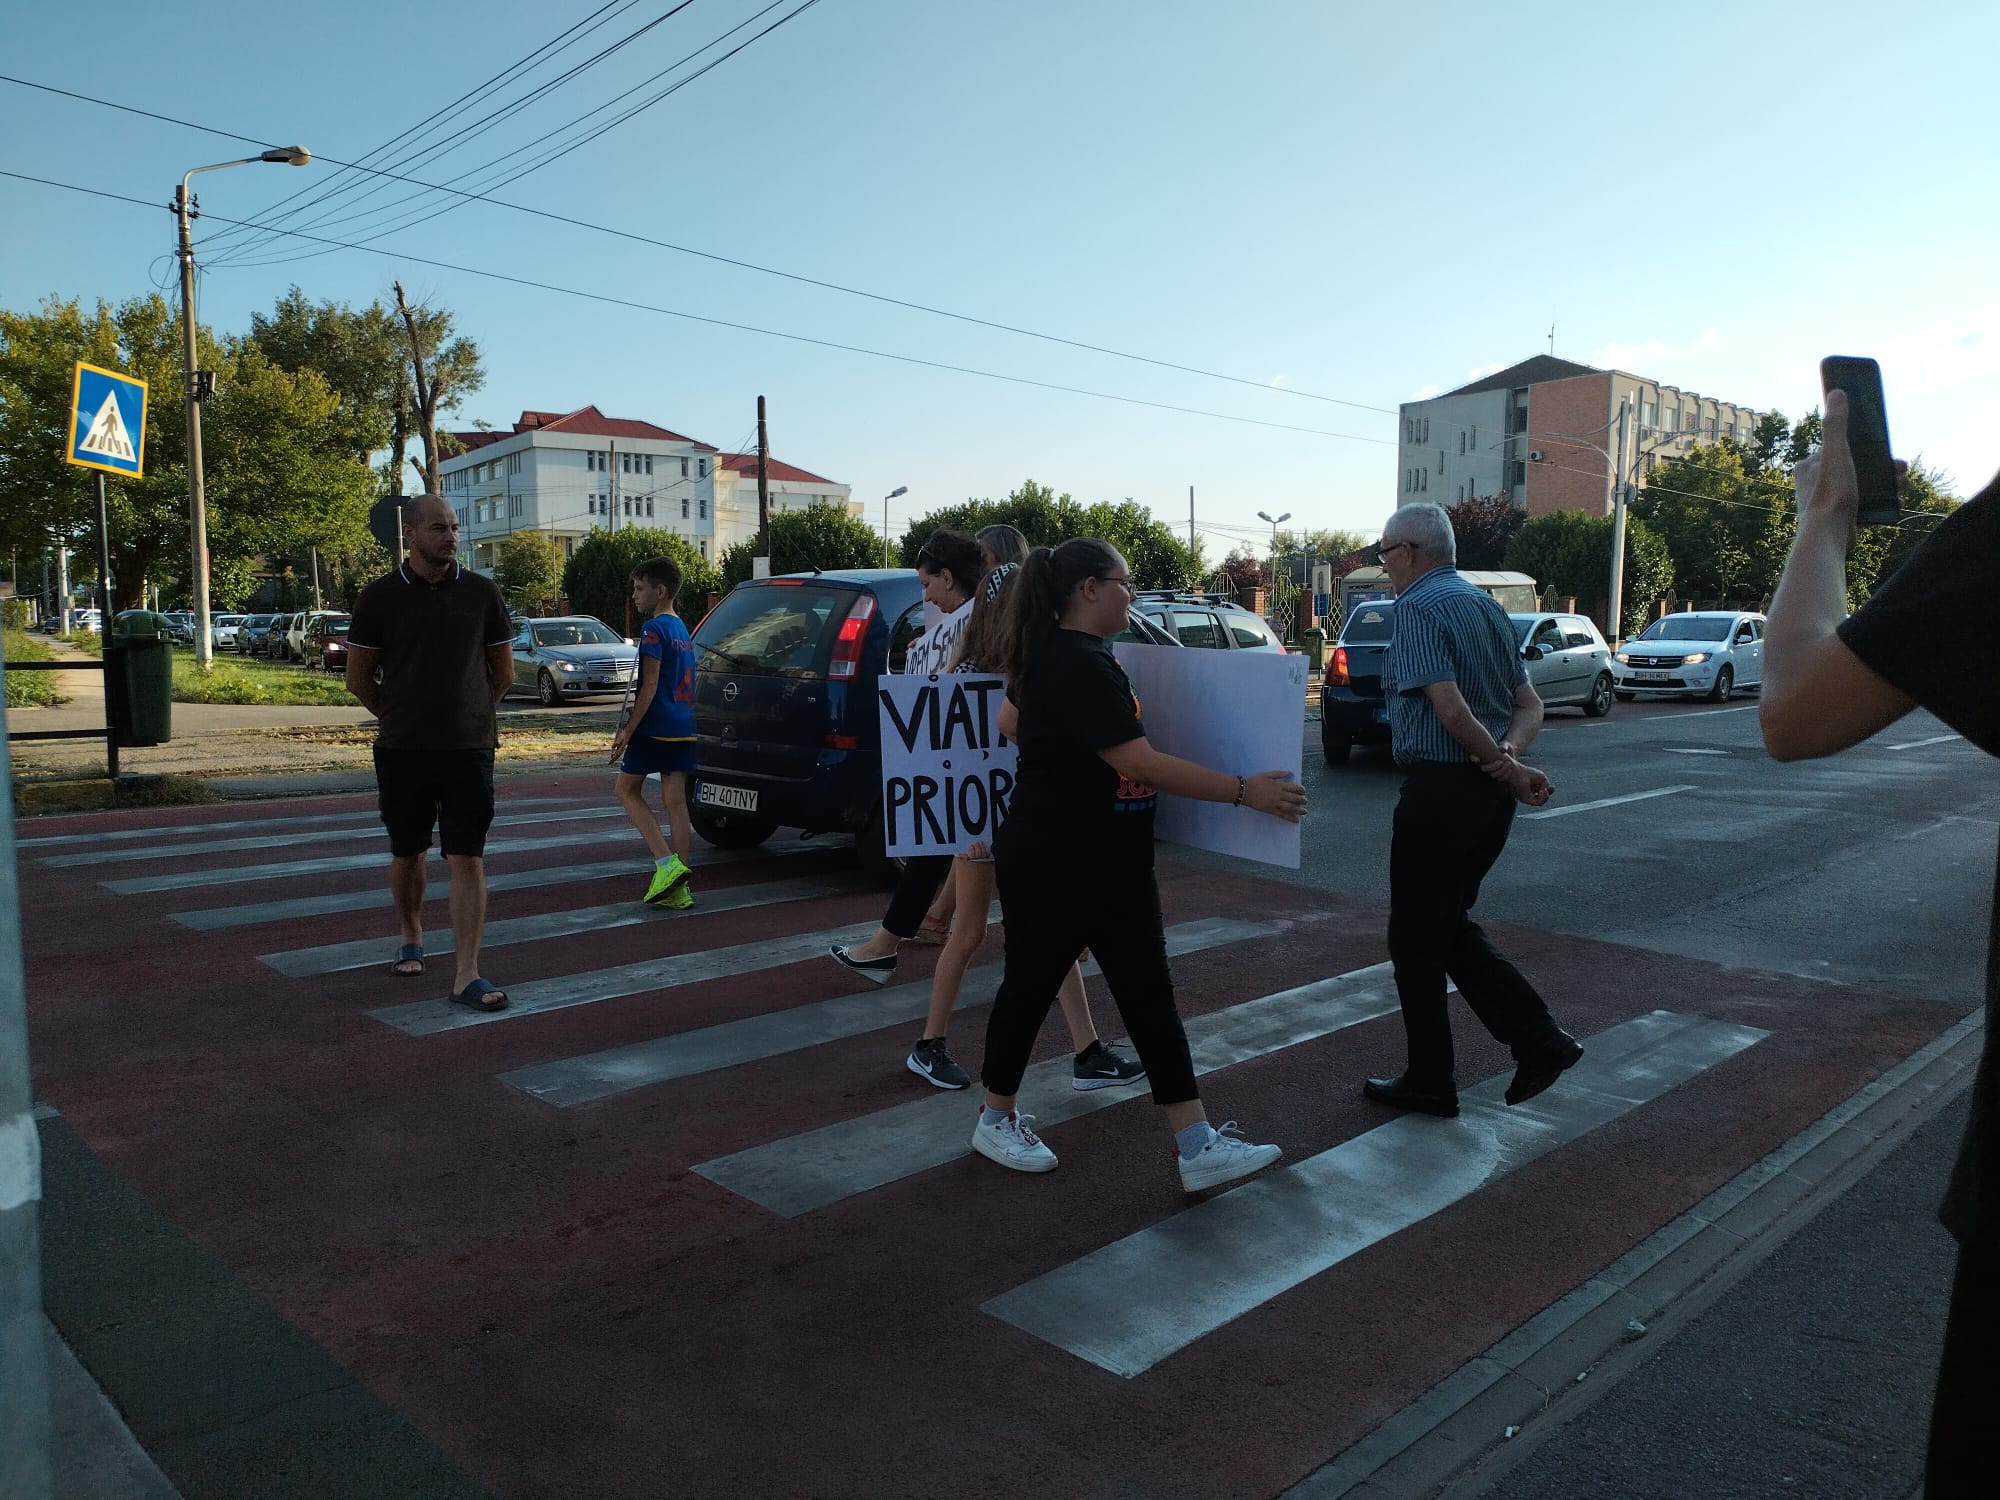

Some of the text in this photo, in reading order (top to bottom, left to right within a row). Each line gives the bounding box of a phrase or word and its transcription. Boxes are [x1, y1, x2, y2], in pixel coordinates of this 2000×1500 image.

[879, 674, 1008, 760] VIAȚ
[702, 785, 716, 802] BH
[886, 760, 1016, 846] PRIOR
